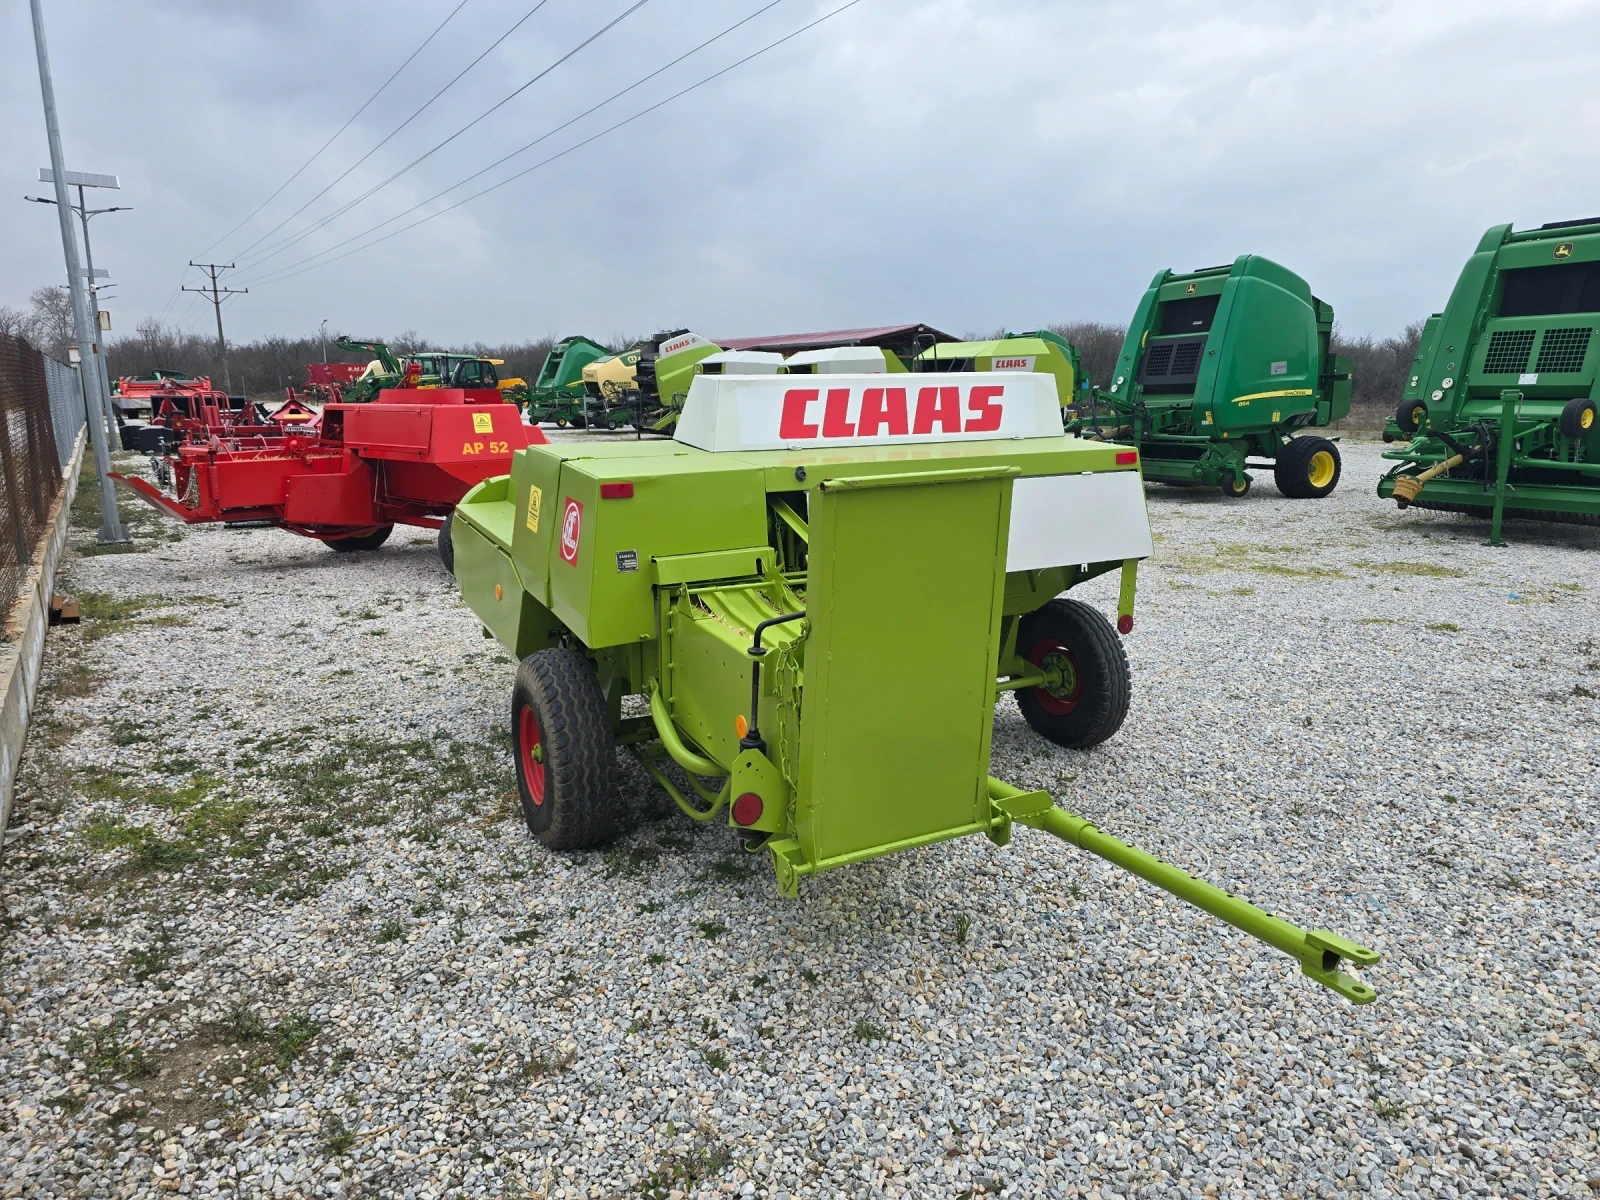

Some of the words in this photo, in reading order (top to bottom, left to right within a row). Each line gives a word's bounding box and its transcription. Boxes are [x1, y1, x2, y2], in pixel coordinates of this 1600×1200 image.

[665, 339, 690, 353] CLAAS
[995, 359, 1027, 369] CLAAS
[779, 386, 1005, 440] CLAAS
[462, 442, 484, 455] AP
[490, 441, 509, 454] 52
